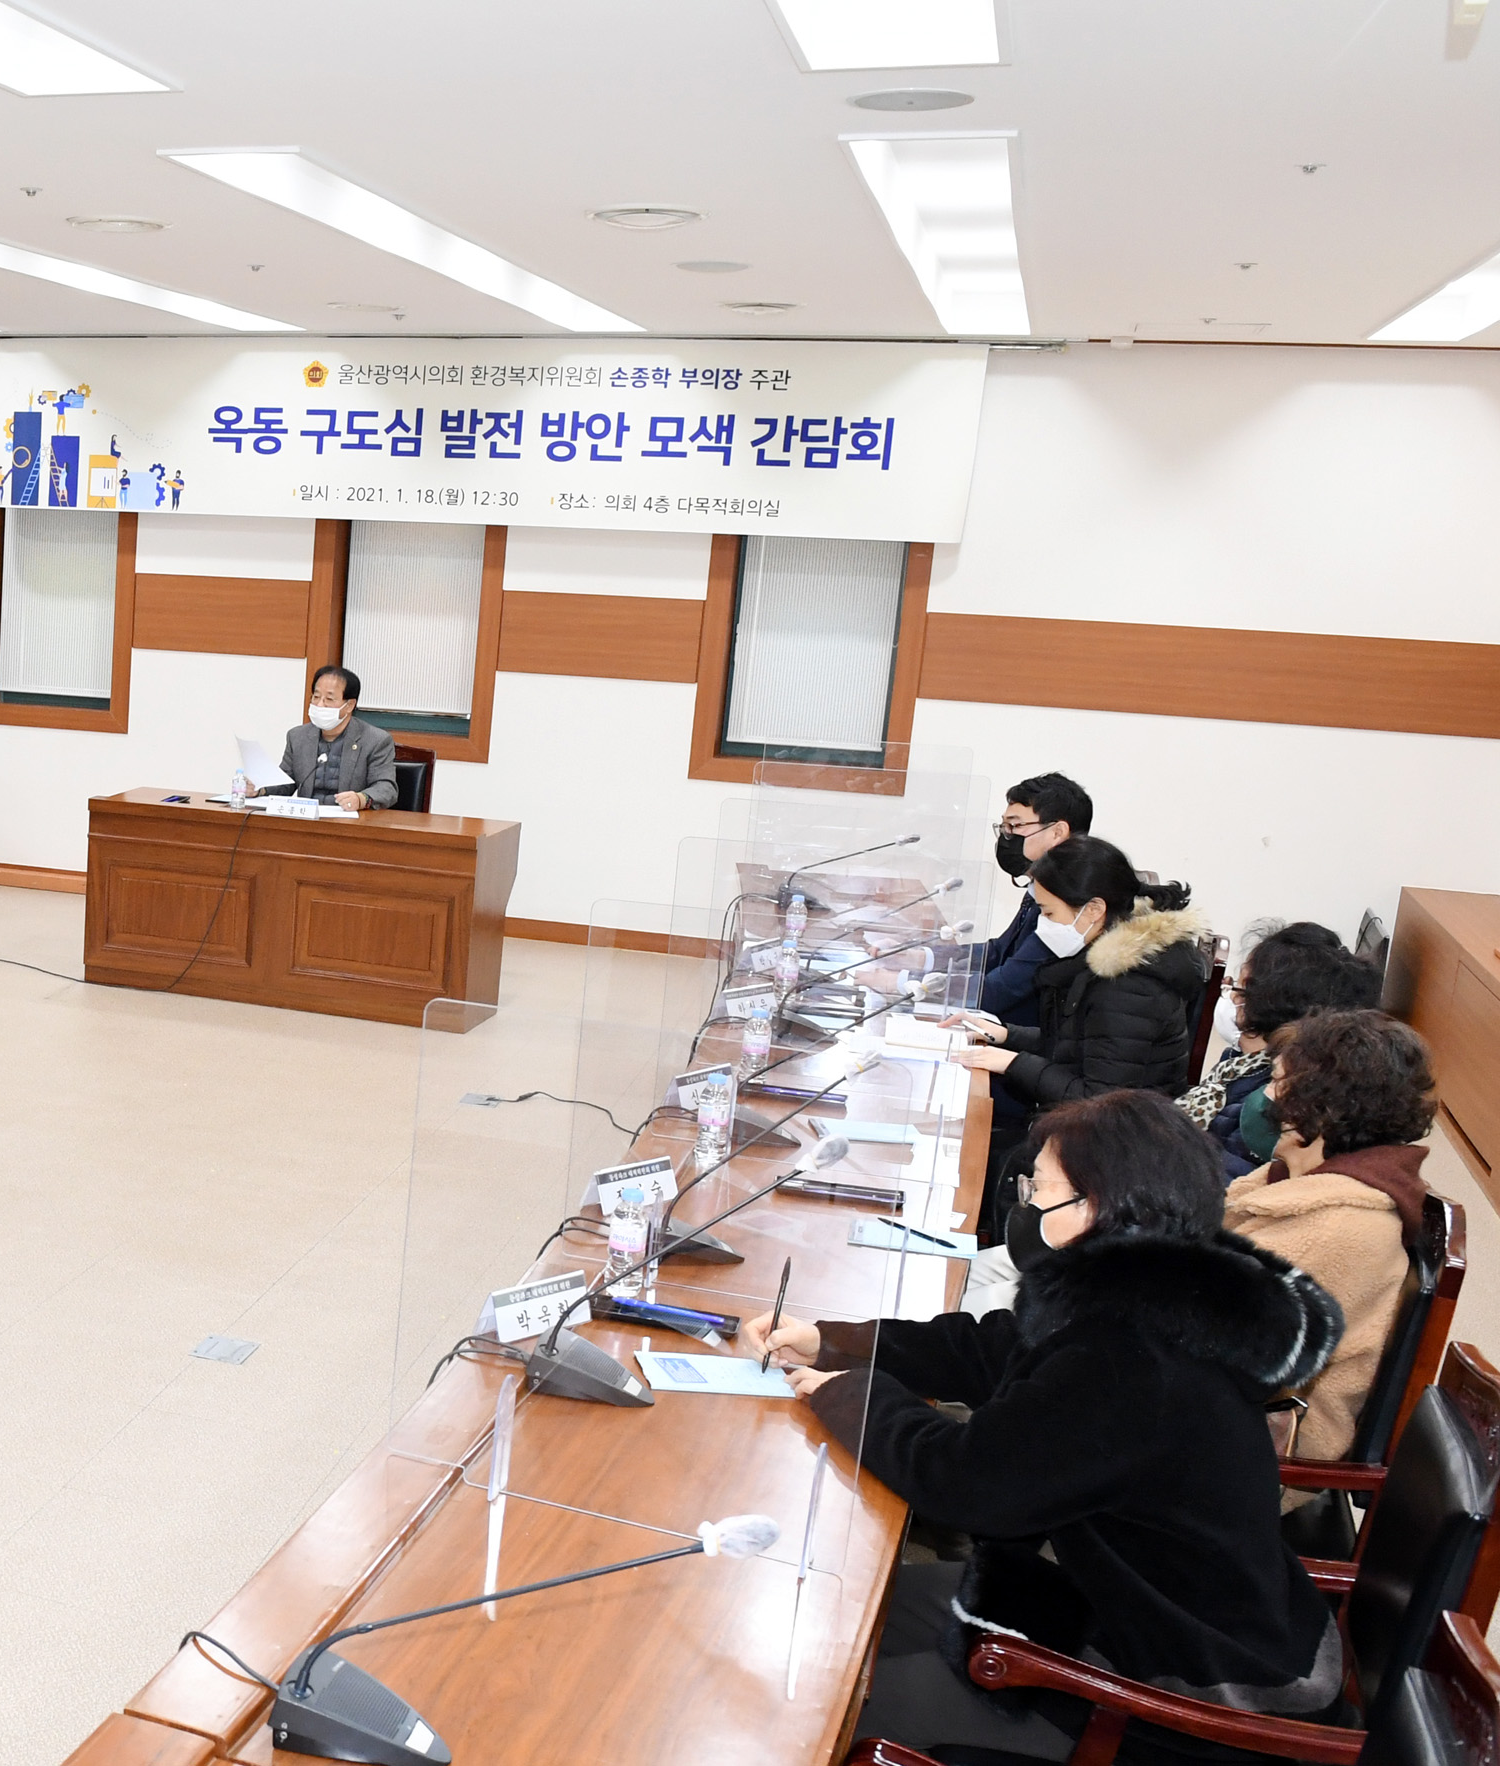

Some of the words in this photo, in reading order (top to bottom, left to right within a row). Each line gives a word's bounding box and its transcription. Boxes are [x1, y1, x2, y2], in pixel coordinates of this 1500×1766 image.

[338, 364, 464, 386] 울산광역시의회
[469, 364, 602, 388] 환경복지위원회
[609, 366, 672, 390] 손종학
[678, 367, 744, 391] 부의장
[749, 369, 792, 392] 주관
[207, 405, 289, 455] 옥동
[299, 407, 424, 458] 구도심
[439, 408, 524, 460] 발전
[540, 410, 631, 463] 방안
[640, 413, 736, 467] 모색
[750, 415, 896, 471] 간담회
[346, 486, 389, 503] 2021.
[397, 488, 408, 504] 1.
[416, 488, 465, 506] 18.(월)
[472, 490, 519, 507] 12:30
[557, 493, 597, 510] 장소:
[604, 494, 637, 512] 의회
[643, 495, 671, 514] 4층
[677, 496, 781, 518] 다목적회의실
